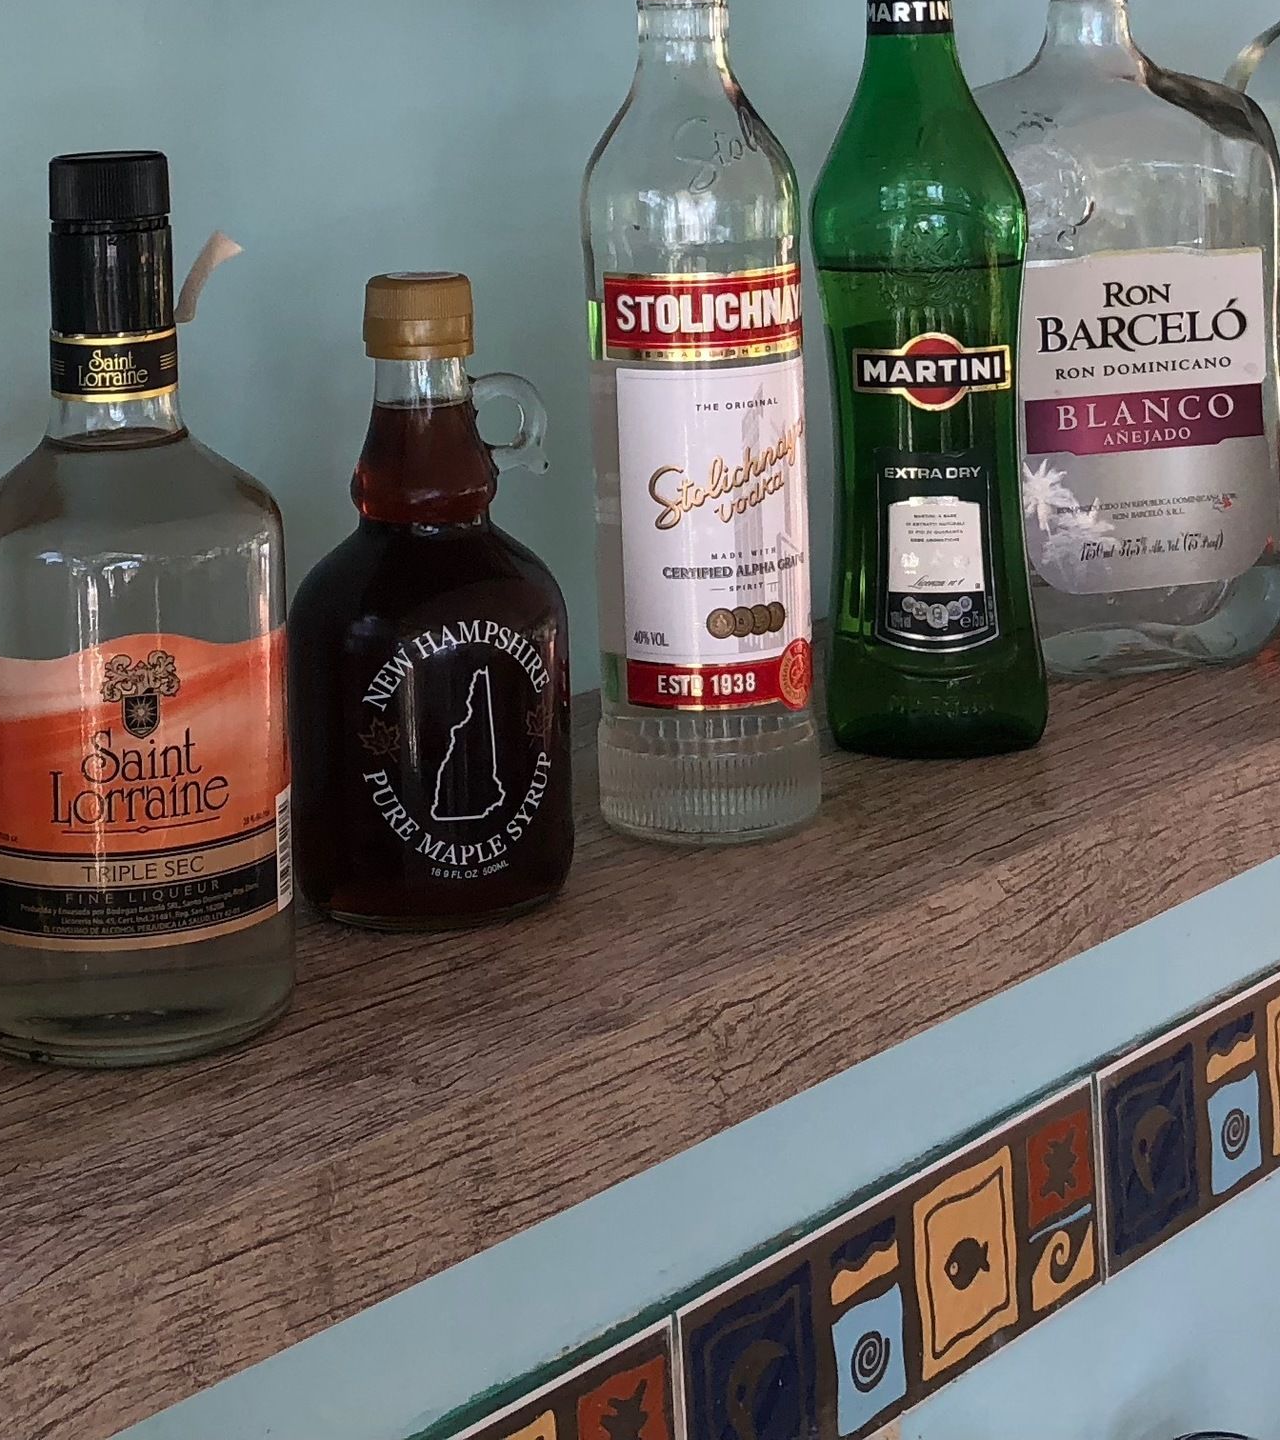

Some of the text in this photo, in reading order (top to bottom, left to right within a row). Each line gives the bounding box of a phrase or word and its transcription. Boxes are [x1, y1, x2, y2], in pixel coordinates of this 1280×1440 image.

[1102, 281, 1172, 308] RON
[616, 284, 802, 334] STOLICHNAY
[1036, 297, 1248, 354] BARCELÓ
[88, 349, 137, 372] Saint
[863, 356, 1003, 384] MARTINI
[1055, 356, 1232, 380] RON DOMINICANO
[78, 365, 149, 387] Lorraine
[695, 397, 779, 412] THE ORIGINAL
[1056, 392, 1236, 432] BLANCO
[1103, 426, 1192, 447] AÑEJADO
[884, 466, 982, 480] EXTRA DRY
[714, 470, 785, 523] vodka
[711, 546, 777, 560] MADE WITH
[662, 565, 734, 580] CERTIFIED
[736, 560, 776, 578] ALPHA
[728, 582, 764, 592] SPIRIT
[362, 620, 551, 712] NEW HAMPSHIRE
[710, 672, 756, 696] 1938
[80, 727, 203, 785] Saint
[49, 774, 231, 828] Lorraine
[363, 751, 552, 866] PURE MAPLE SYRUP
[81, 856, 205, 884] TRIPLE SEC
[451, 870, 463, 879] FL
[464, 868, 478, 879] OZ
[65, 879, 220, 905] FINE LIQUEUR
